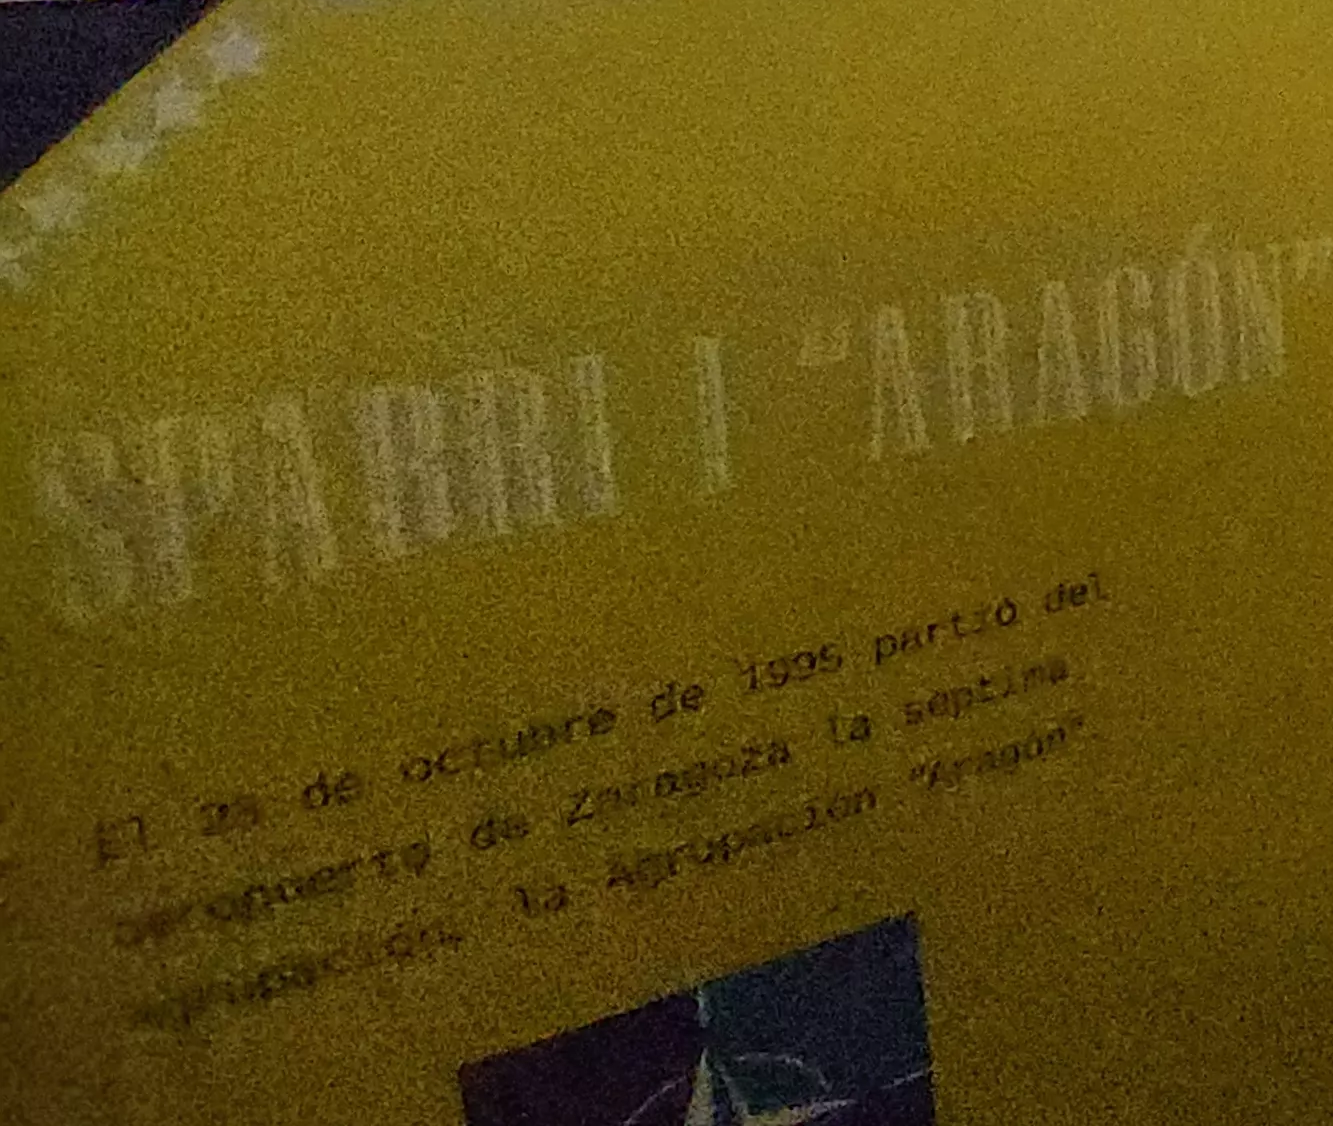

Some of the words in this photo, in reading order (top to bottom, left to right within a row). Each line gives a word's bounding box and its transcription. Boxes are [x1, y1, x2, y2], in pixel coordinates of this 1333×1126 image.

[96, 812, 148, 868] El
[301, 768, 364, 812] de
[400, 706, 614, 784] octubre
[650, 682, 705, 724] de
[744, 642, 844, 694] 1995
[874, 596, 1018, 667] partió
[1043, 570, 1110, 616] del
[469, 814, 531, 854] de
[567, 739, 793, 827] Zaragoza
[827, 710, 873, 748] la
[512, 879, 570, 919] la
